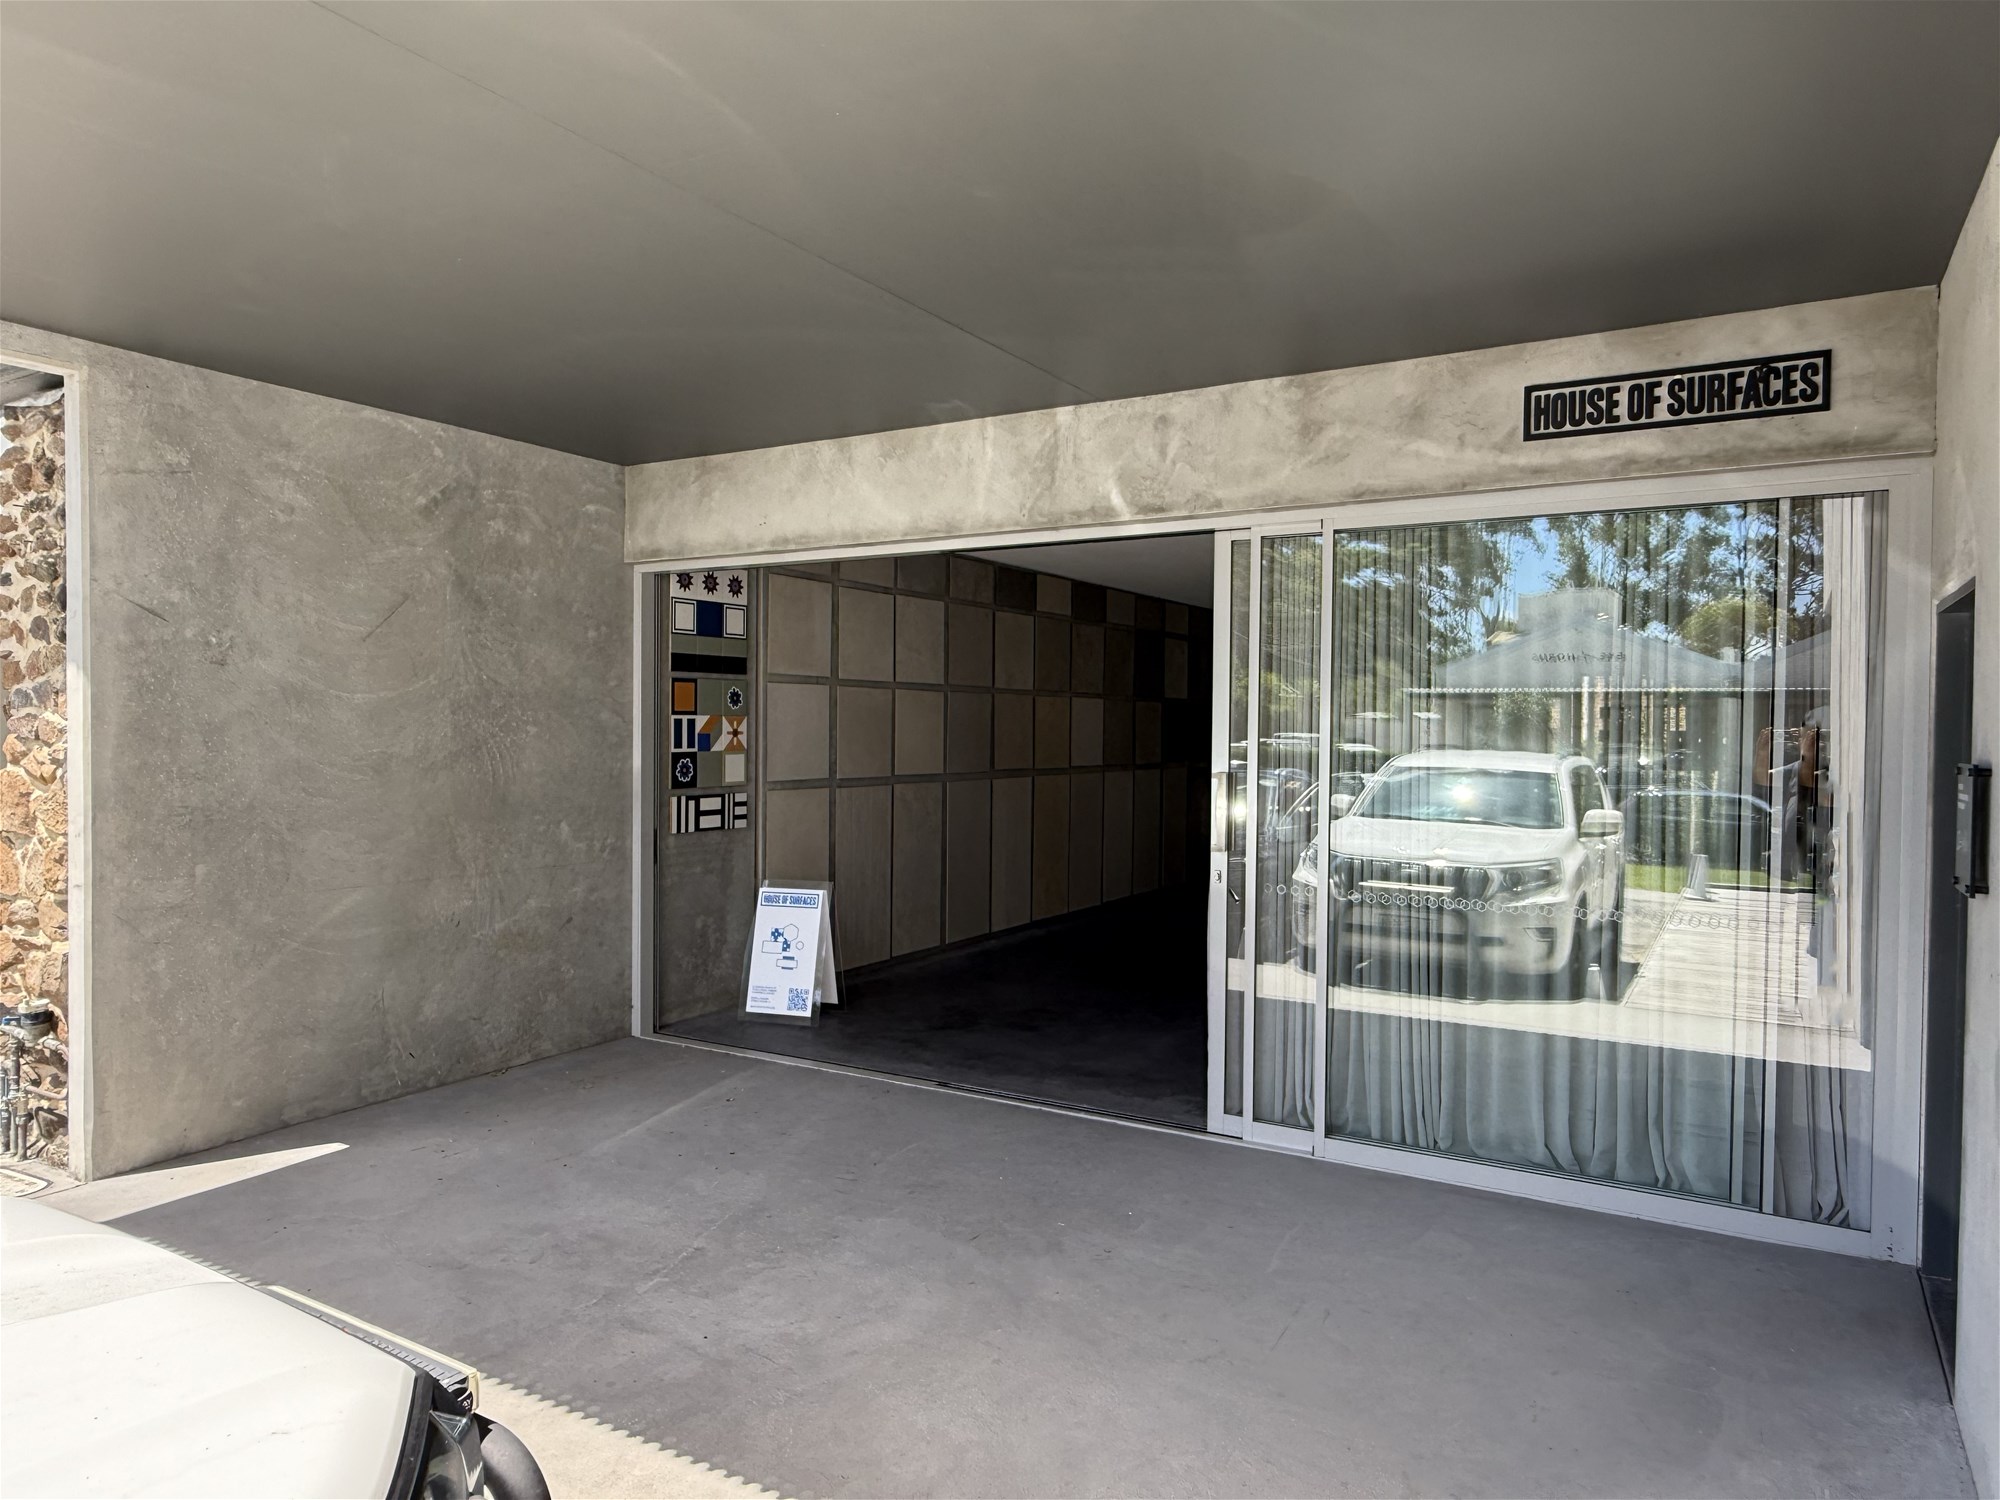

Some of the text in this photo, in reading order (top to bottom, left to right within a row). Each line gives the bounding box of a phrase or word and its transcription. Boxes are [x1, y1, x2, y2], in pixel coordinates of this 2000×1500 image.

[1533, 362, 1819, 431] HOUSE OF SURFACES
[763, 893, 817, 906] HOUSE OF SURFACES
